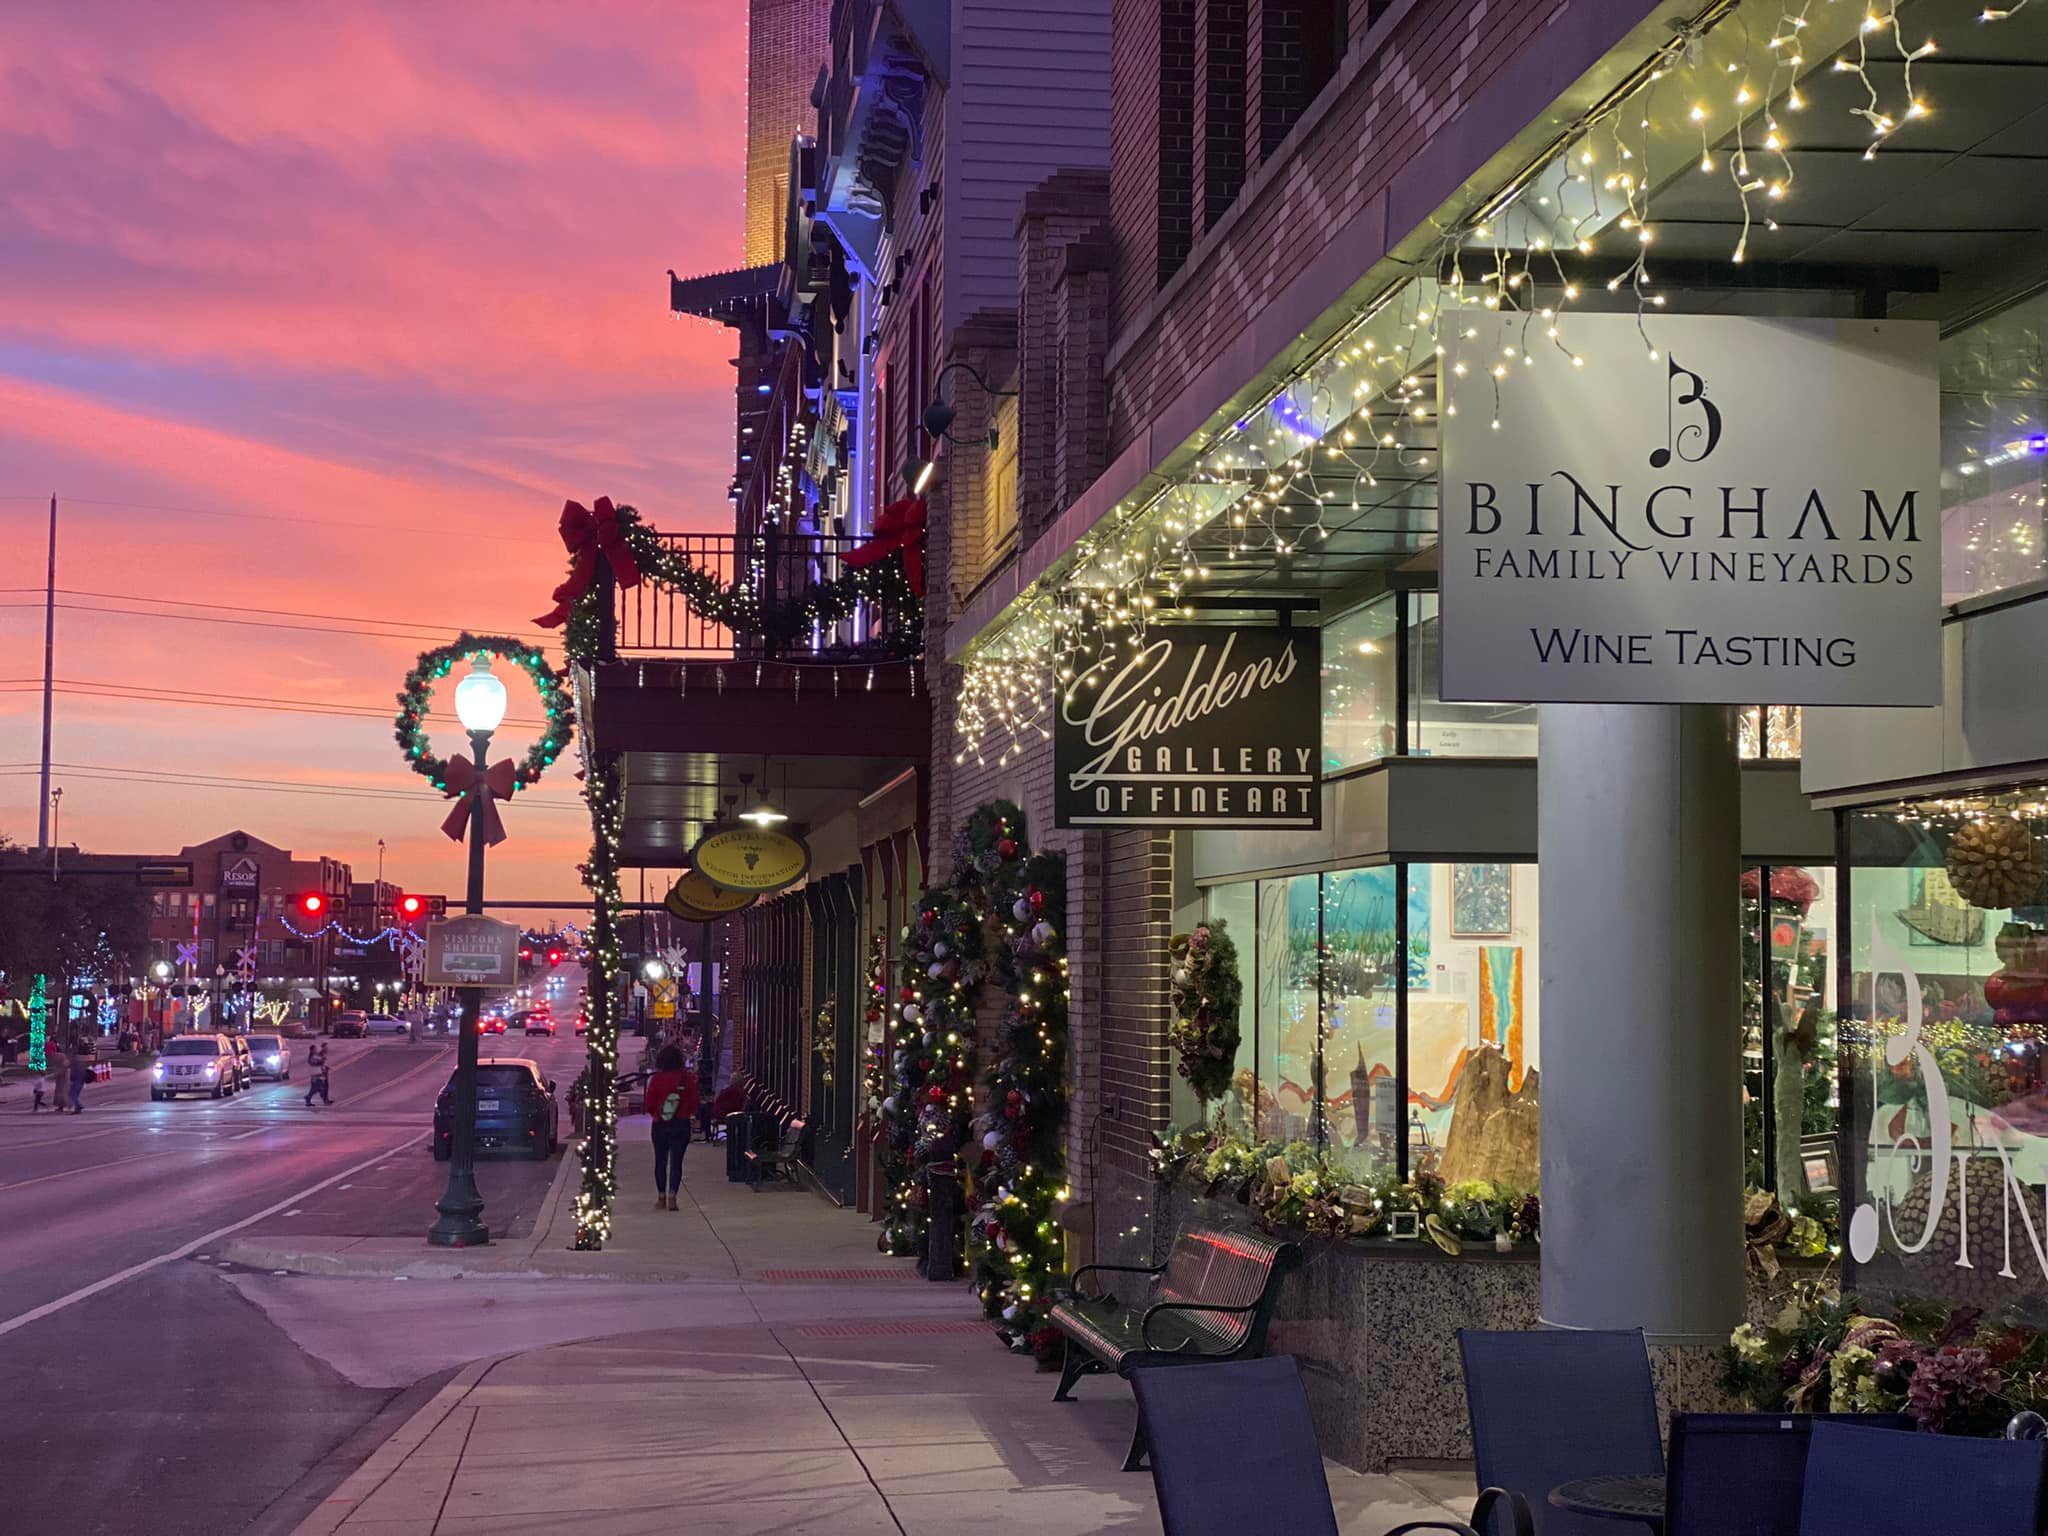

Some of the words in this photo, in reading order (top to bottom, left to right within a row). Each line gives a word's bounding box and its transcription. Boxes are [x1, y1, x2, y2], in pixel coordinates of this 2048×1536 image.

[1465, 470, 1923, 550] BINGHAM
[1473, 547, 1632, 580] FAMILY
[1656, 551, 1914, 584] VINEYARDS
[1530, 627, 1653, 665] WINE
[1665, 629, 1857, 668] TASTING
[1062, 631, 1298, 791] Giddens
[1127, 746, 1312, 774] GALLERY
[1095, 786, 1134, 812] OF
[1151, 787, 1229, 813] FINE
[1247, 787, 1312, 812] ART
[443, 934, 504, 944] VISITORS
[444, 943, 500, 953] SHUTTLE
[455, 973, 487, 982] STOP
